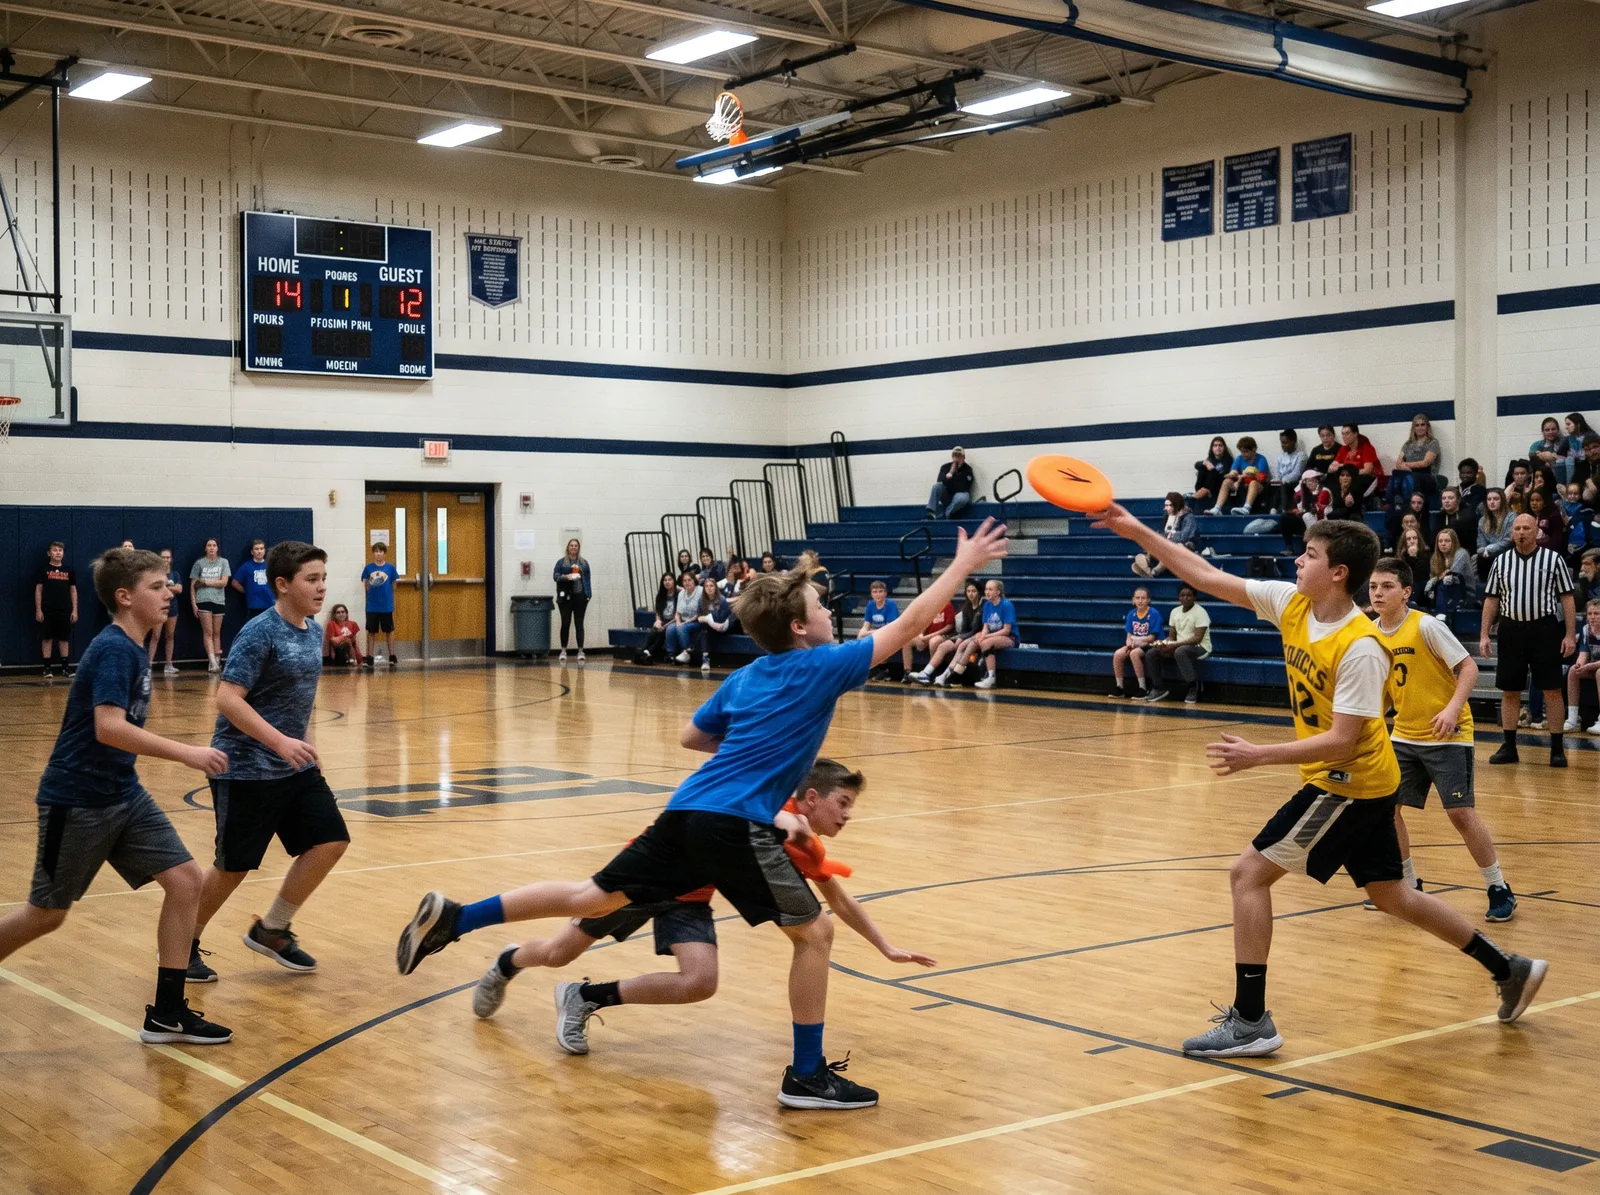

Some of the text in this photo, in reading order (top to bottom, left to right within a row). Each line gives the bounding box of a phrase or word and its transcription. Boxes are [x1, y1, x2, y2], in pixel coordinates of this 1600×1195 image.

[258, 256, 300, 274] HOME
[379, 266, 423, 284] GUEST
[275, 281, 301, 308] 14
[344, 288, 349, 309] 1
[400, 288, 422, 318] 12
[253, 313, 284, 326] POURS
[398, 323, 426, 334] POULE
